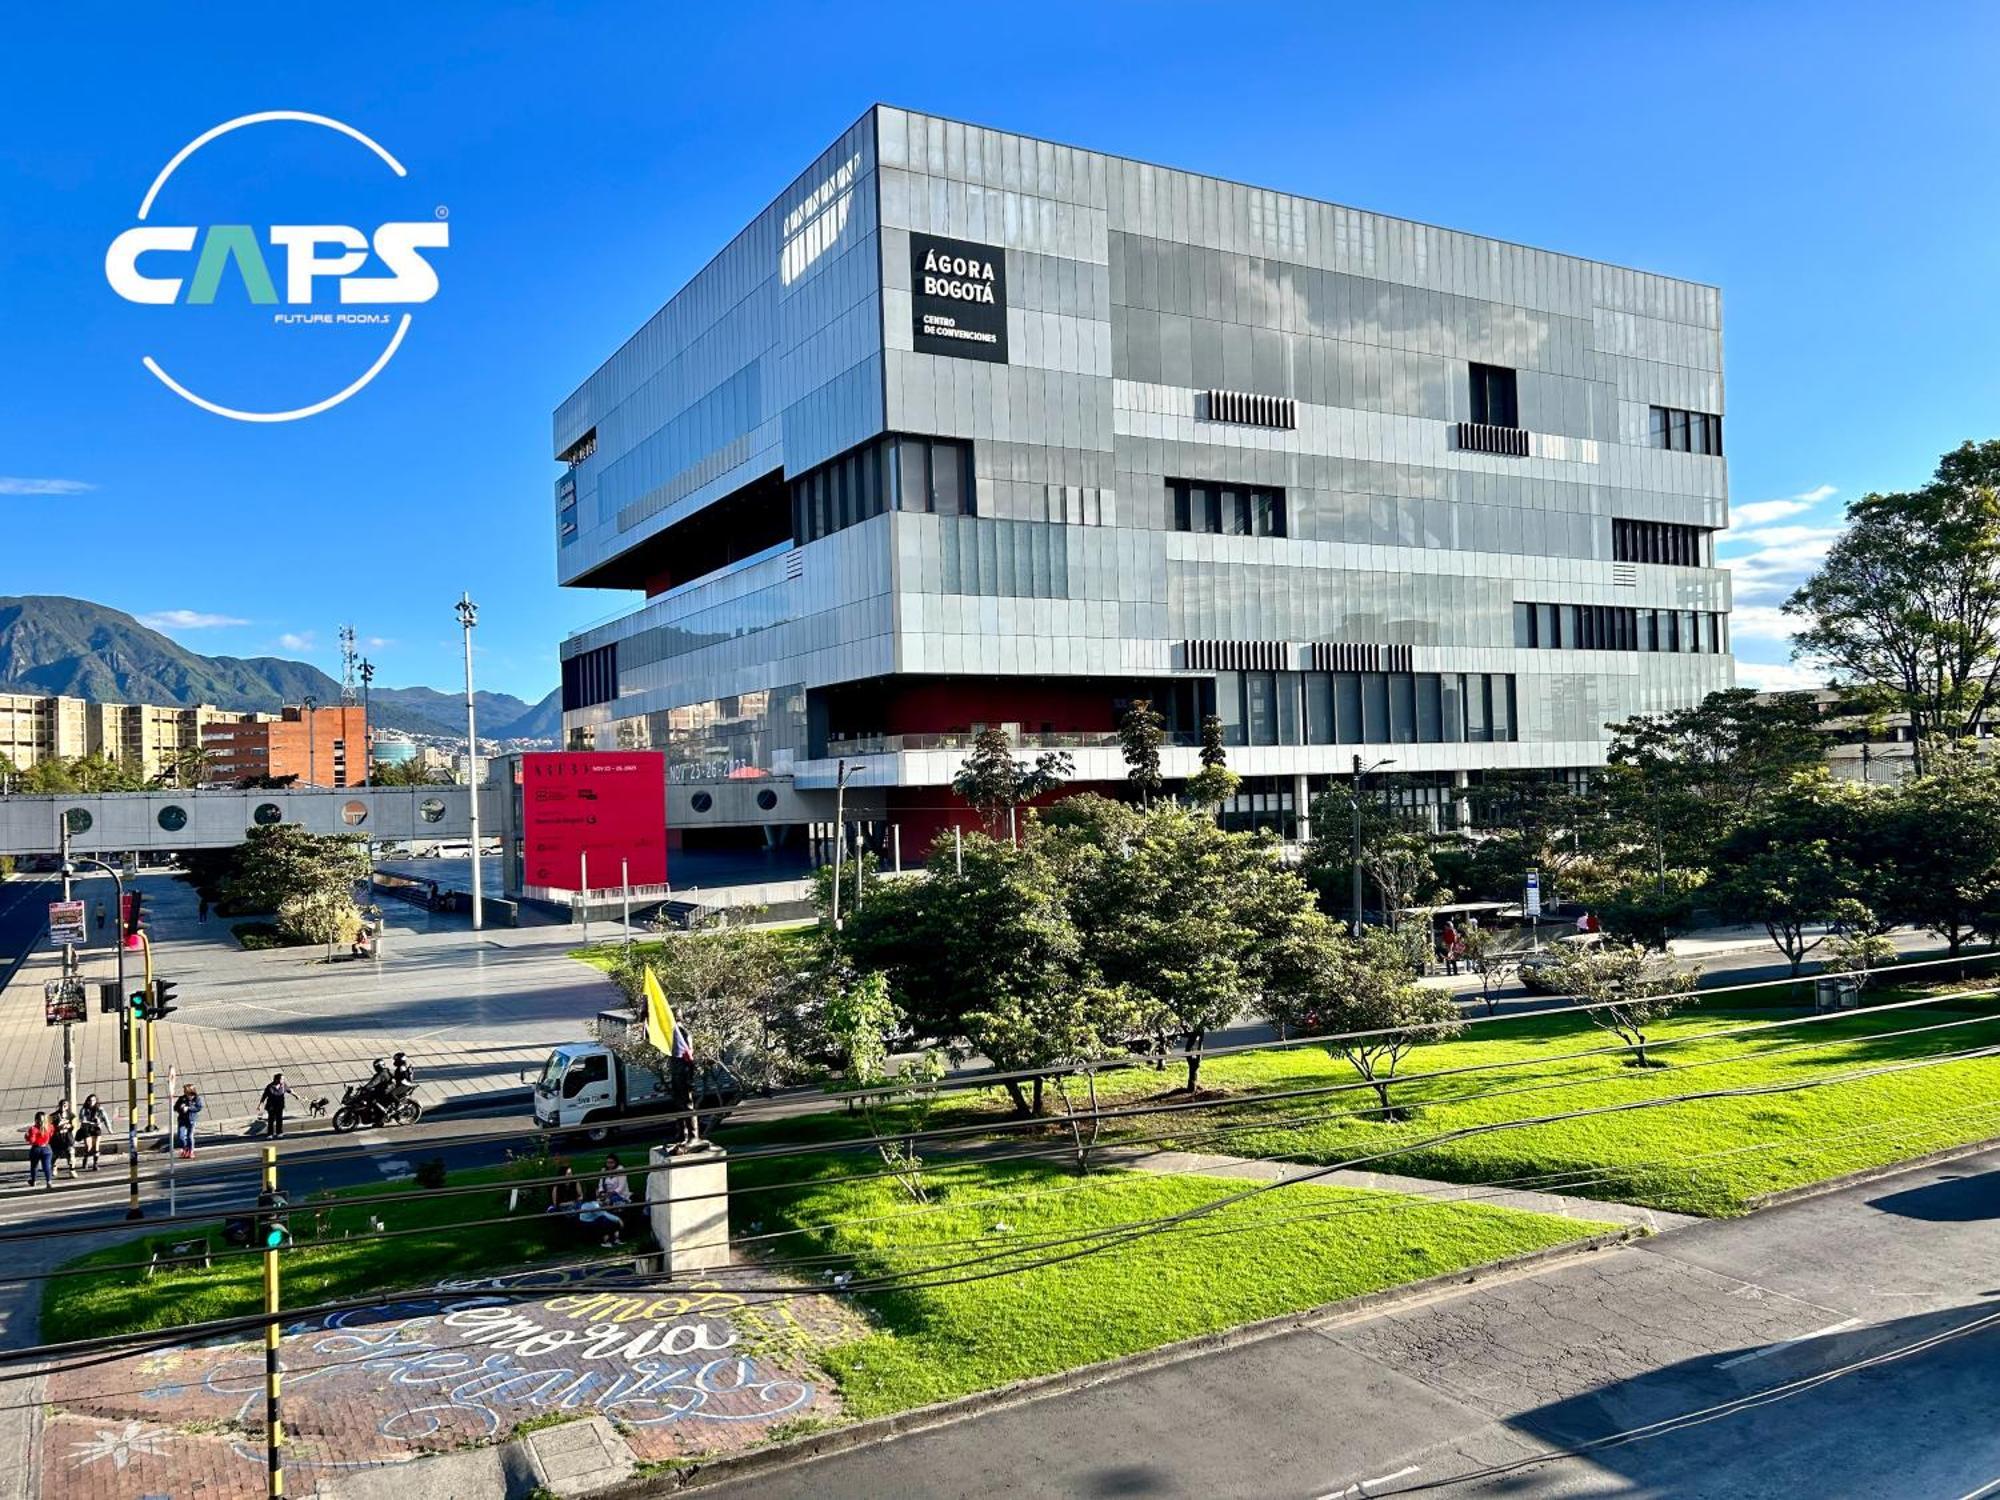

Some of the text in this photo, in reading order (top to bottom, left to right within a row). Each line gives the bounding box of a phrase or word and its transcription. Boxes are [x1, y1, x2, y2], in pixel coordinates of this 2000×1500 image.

[924, 249, 995, 281] ÁGORA
[924, 276, 995, 304] BOGOTÁ
[924, 315, 955, 327] CENTRO
[924, 325, 997, 342] DE CONVENCIONES
